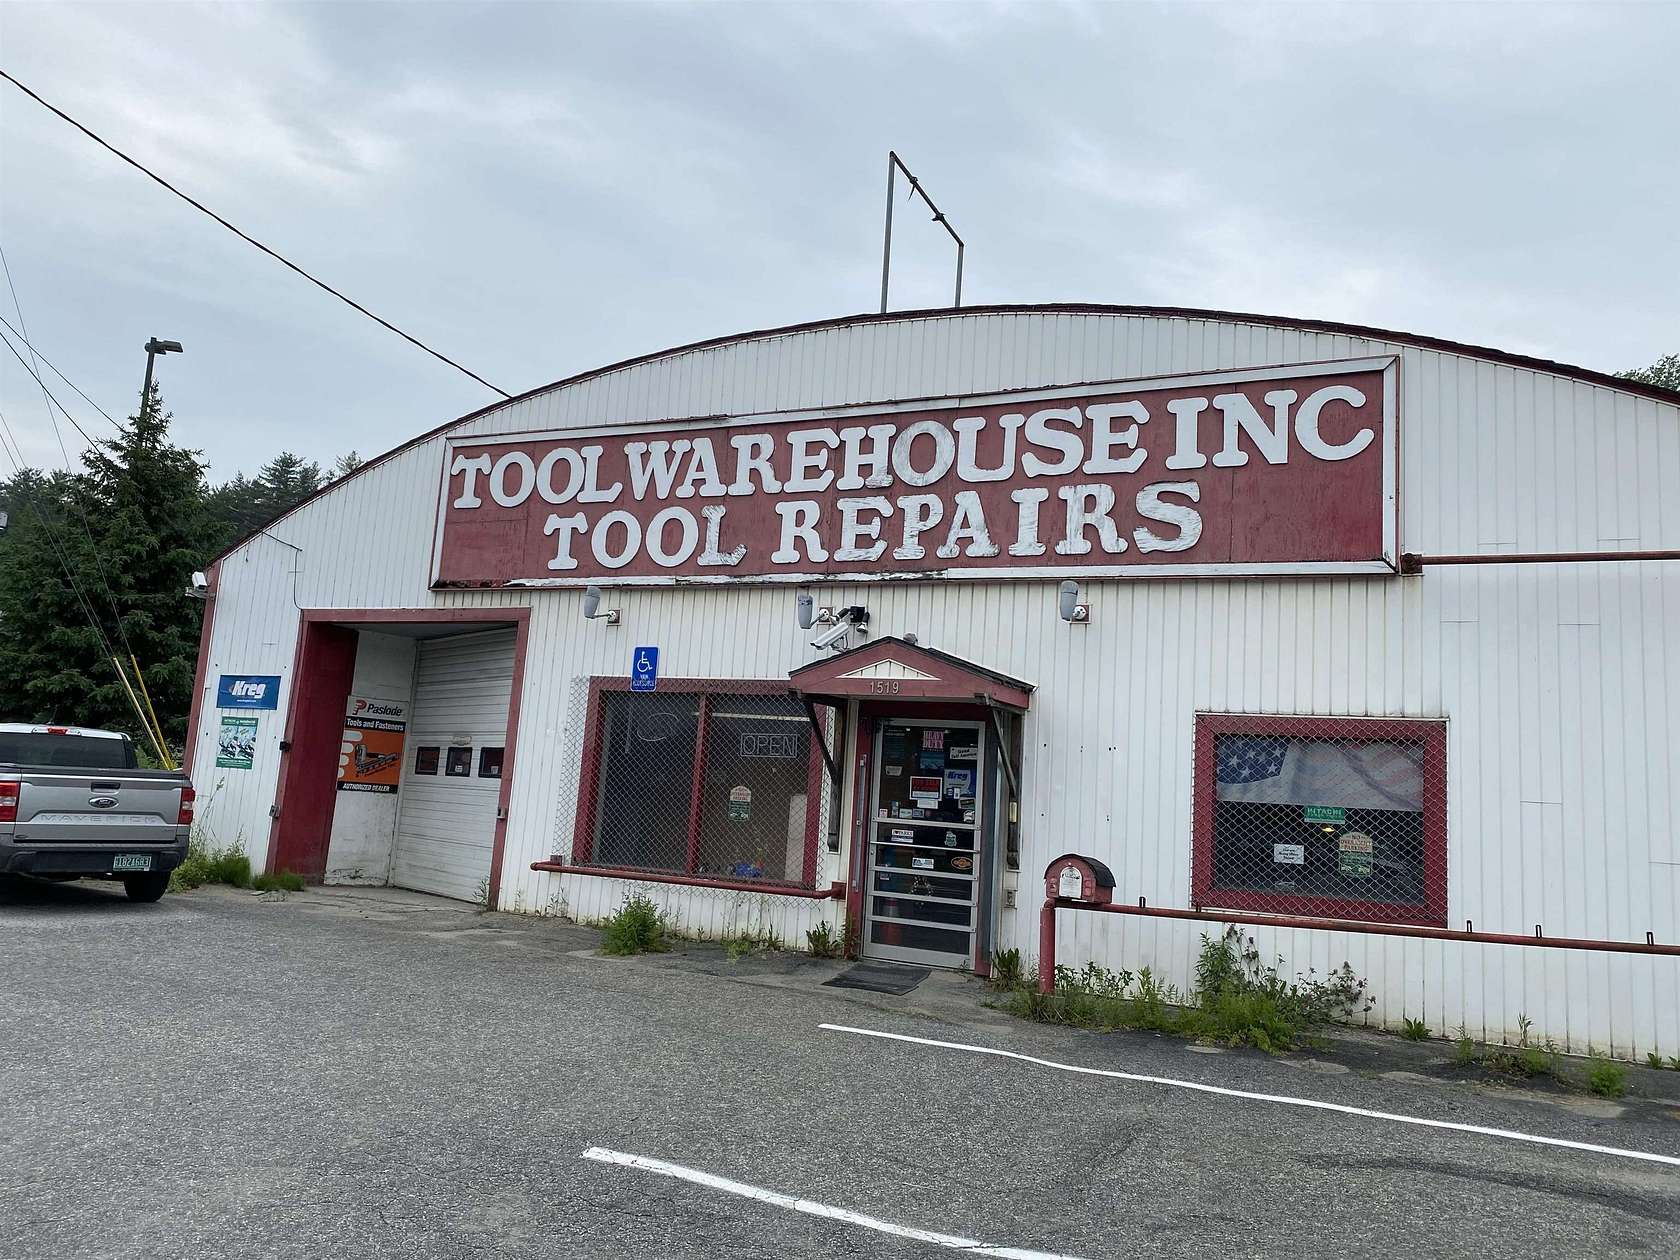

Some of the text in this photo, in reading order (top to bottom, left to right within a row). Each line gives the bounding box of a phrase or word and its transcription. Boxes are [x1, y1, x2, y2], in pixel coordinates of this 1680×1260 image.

[451, 385, 1375, 509] TOOL WAREHOUSE INC
[544, 480, 1203, 570] TOOL REPAIRS
[231, 680, 266, 699] Kreg
[869, 681, 900, 694] 1519
[367, 703, 402, 717] Paslode
[347, 718, 404, 731] Tools and Fasteners
[743, 735, 796, 756] OPEN
